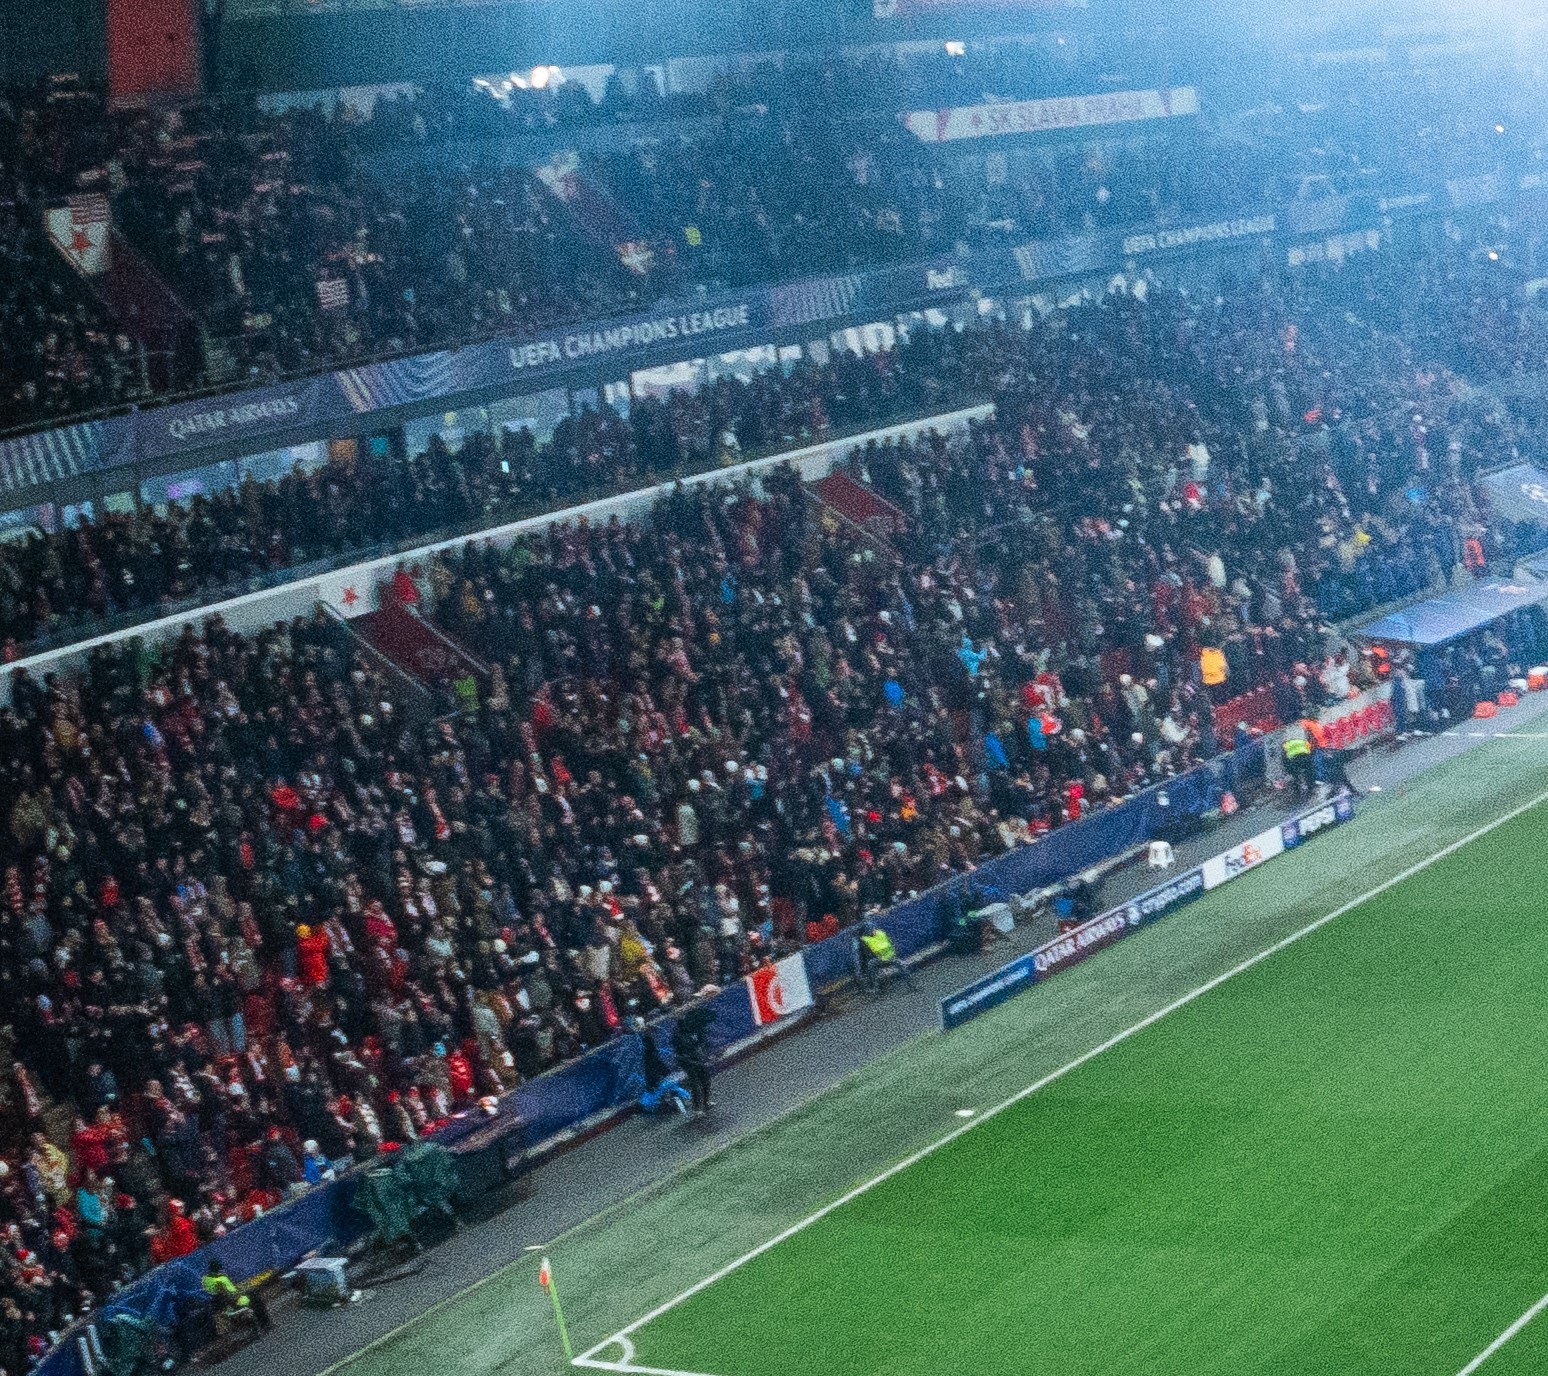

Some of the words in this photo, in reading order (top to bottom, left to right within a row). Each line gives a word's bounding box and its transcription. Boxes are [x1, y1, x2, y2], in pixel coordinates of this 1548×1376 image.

[510, 341, 561, 368] UEFA
[564, 318, 678, 358] CHAMPIONS
[680, 304, 748, 335] LEAGUE
[1034, 937, 1077, 971] QATAR
[1074, 912, 1126, 950] AIRWAYS
